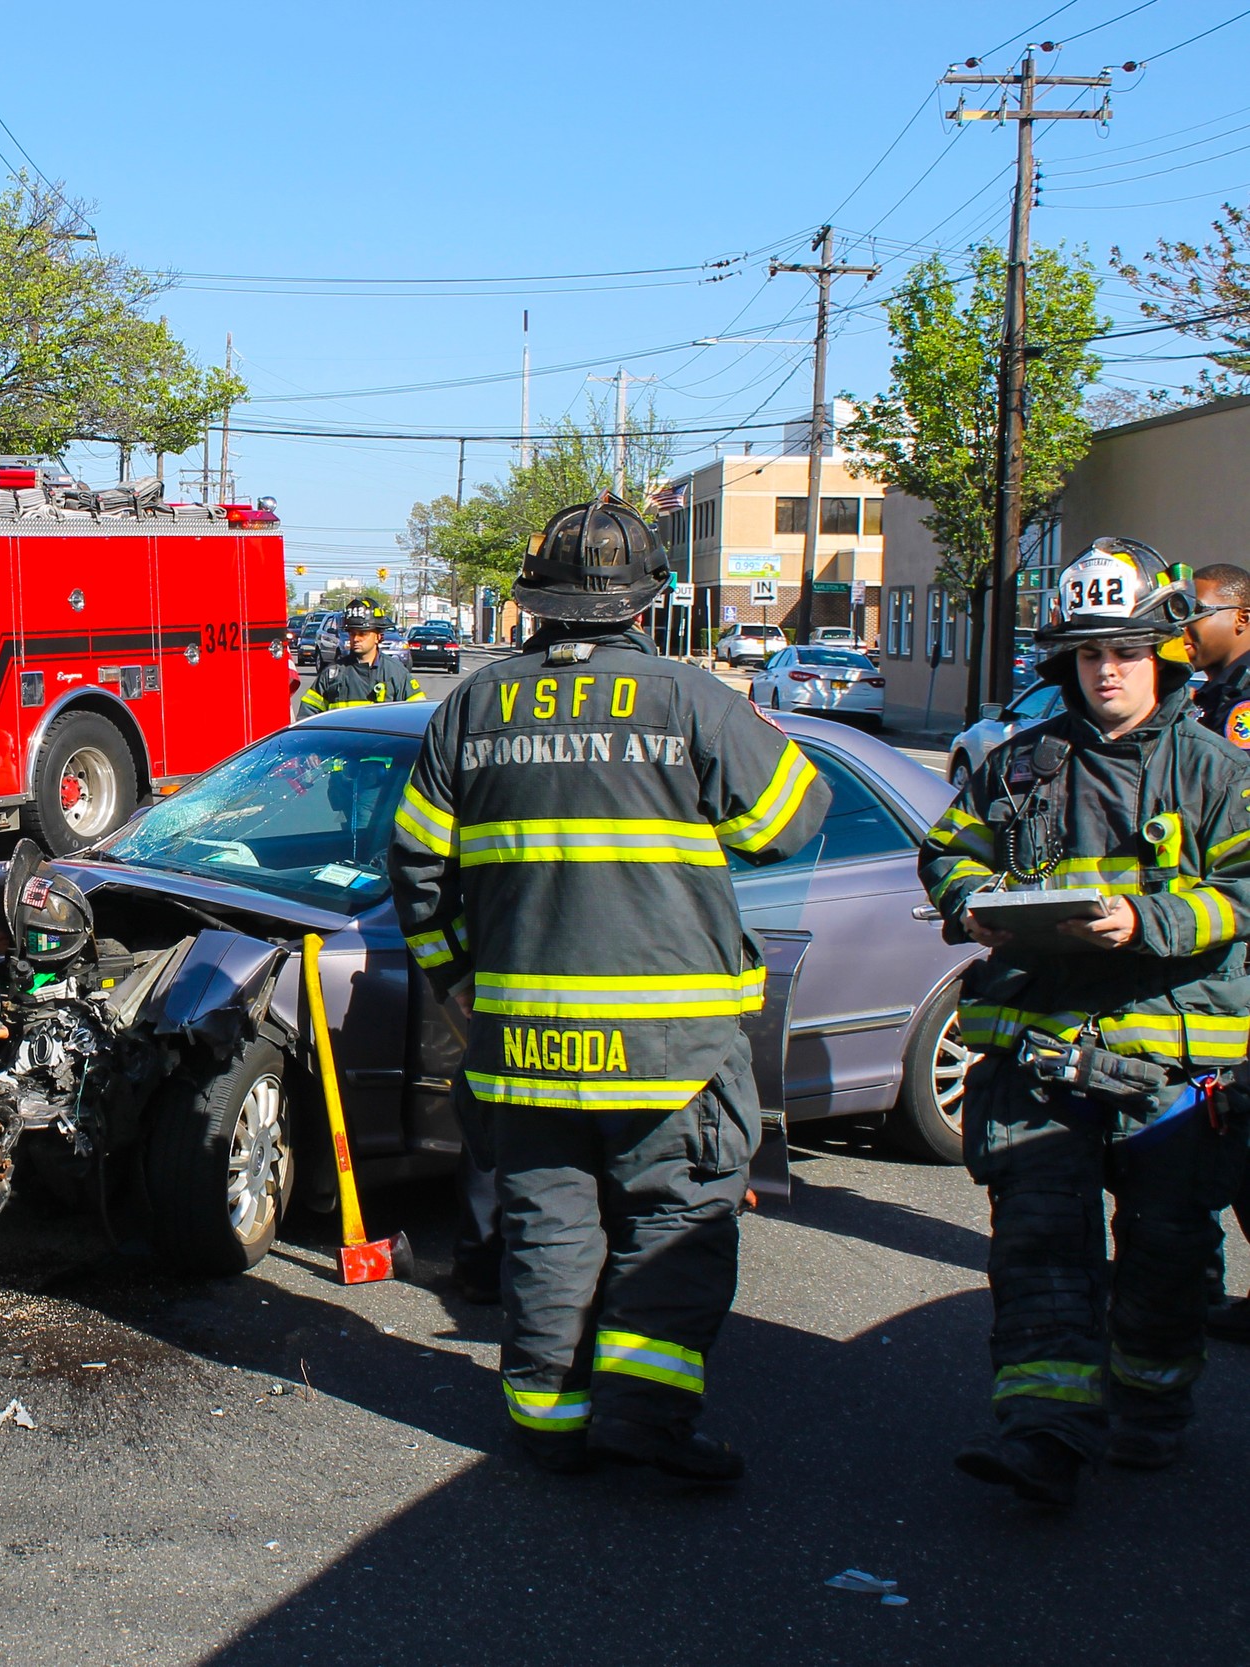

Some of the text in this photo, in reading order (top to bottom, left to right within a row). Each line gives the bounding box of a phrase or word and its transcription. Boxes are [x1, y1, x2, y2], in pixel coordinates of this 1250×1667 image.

[675, 586, 693, 595] OUT
[757, 581, 772, 593] IN
[1069, 578, 1126, 611] 342
[347, 606, 366, 618] 342
[205, 621, 240, 654] 342
[461, 732, 686, 772] BROOKLYN AVE
[503, 1026, 628, 1073] NAGODA
